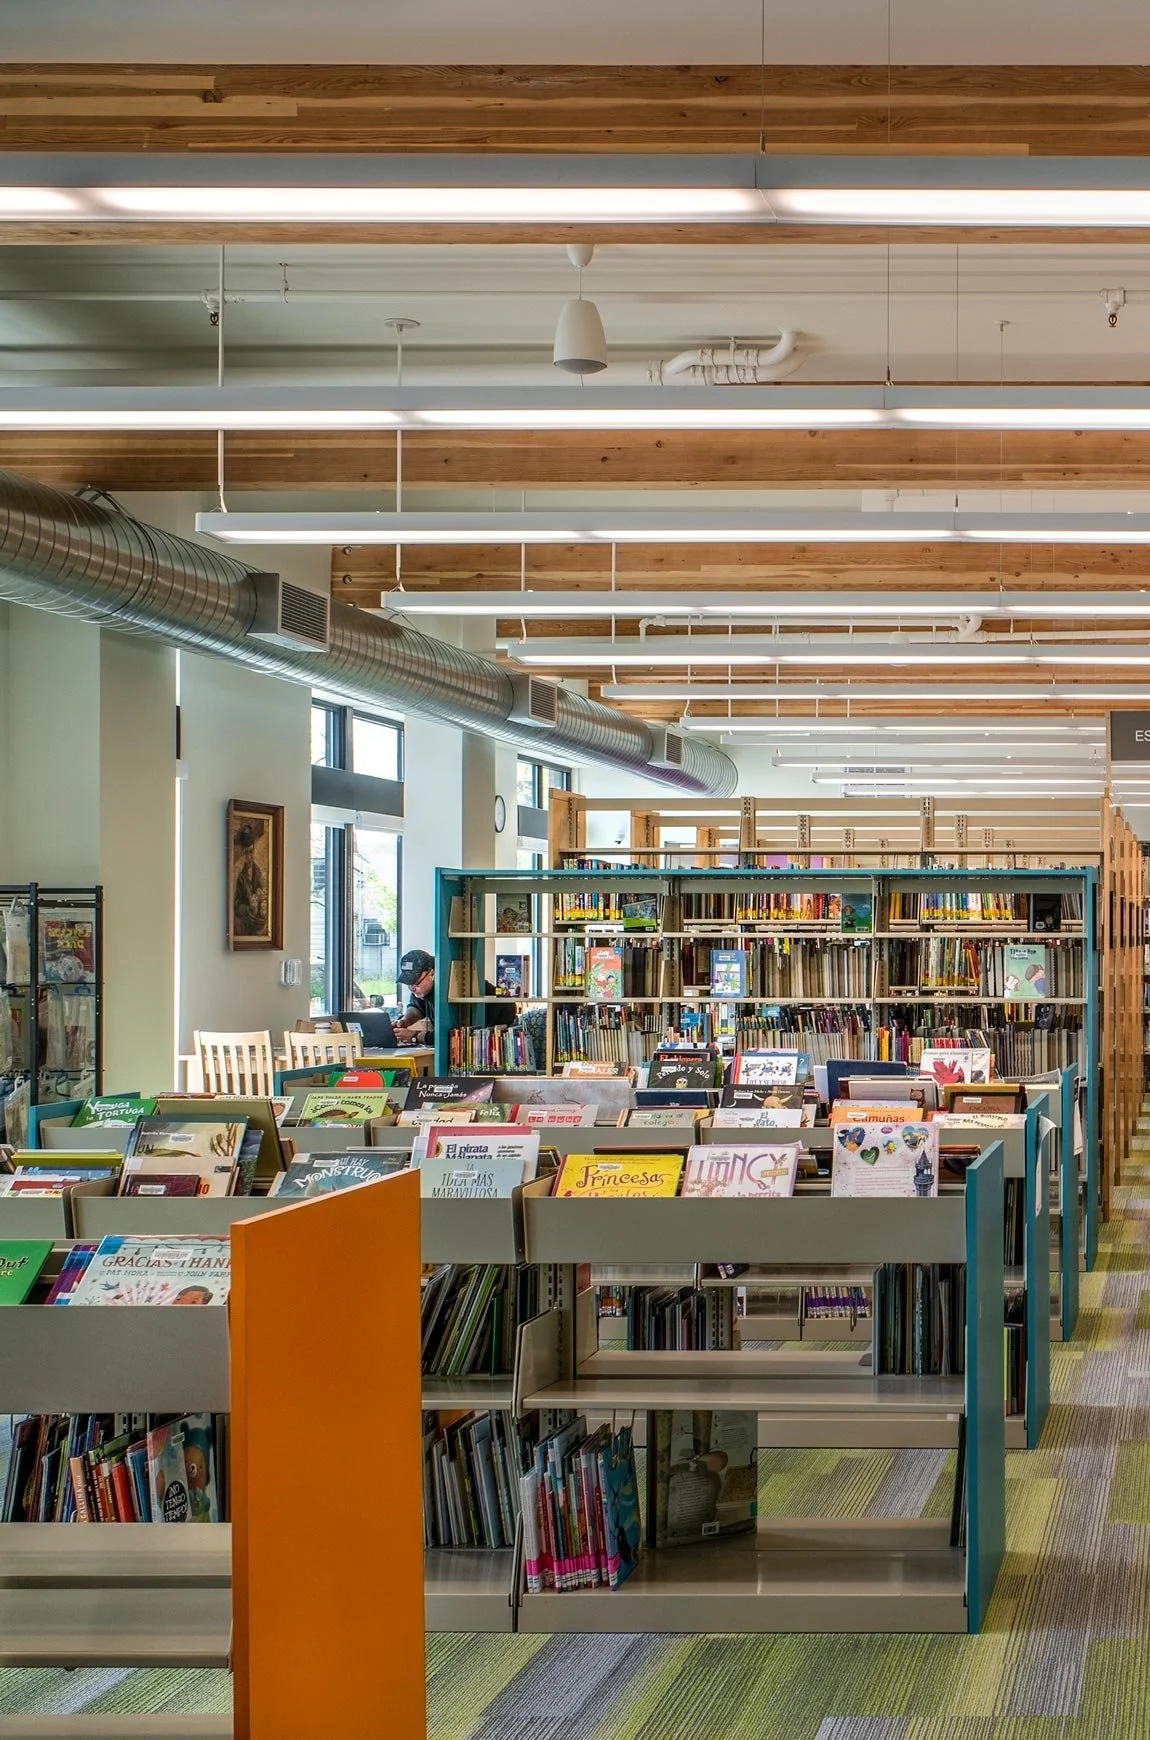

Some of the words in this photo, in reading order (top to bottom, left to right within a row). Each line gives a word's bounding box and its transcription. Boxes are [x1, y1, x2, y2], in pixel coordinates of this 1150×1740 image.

[416, 1081, 426, 1090] La
[97, 1107, 145, 1120] TORTUGA
[446, 1144, 457, 1154] El
[459, 1144, 489, 1155] pirata
[350, 1157, 370, 1167] HAY
[466, 1163, 475, 1171] LA
[576, 1165, 673, 1188] Princesas
[102, 1256, 172, 1268] GRACIAS
[76, 1489, 87, 1519] GALLINA
